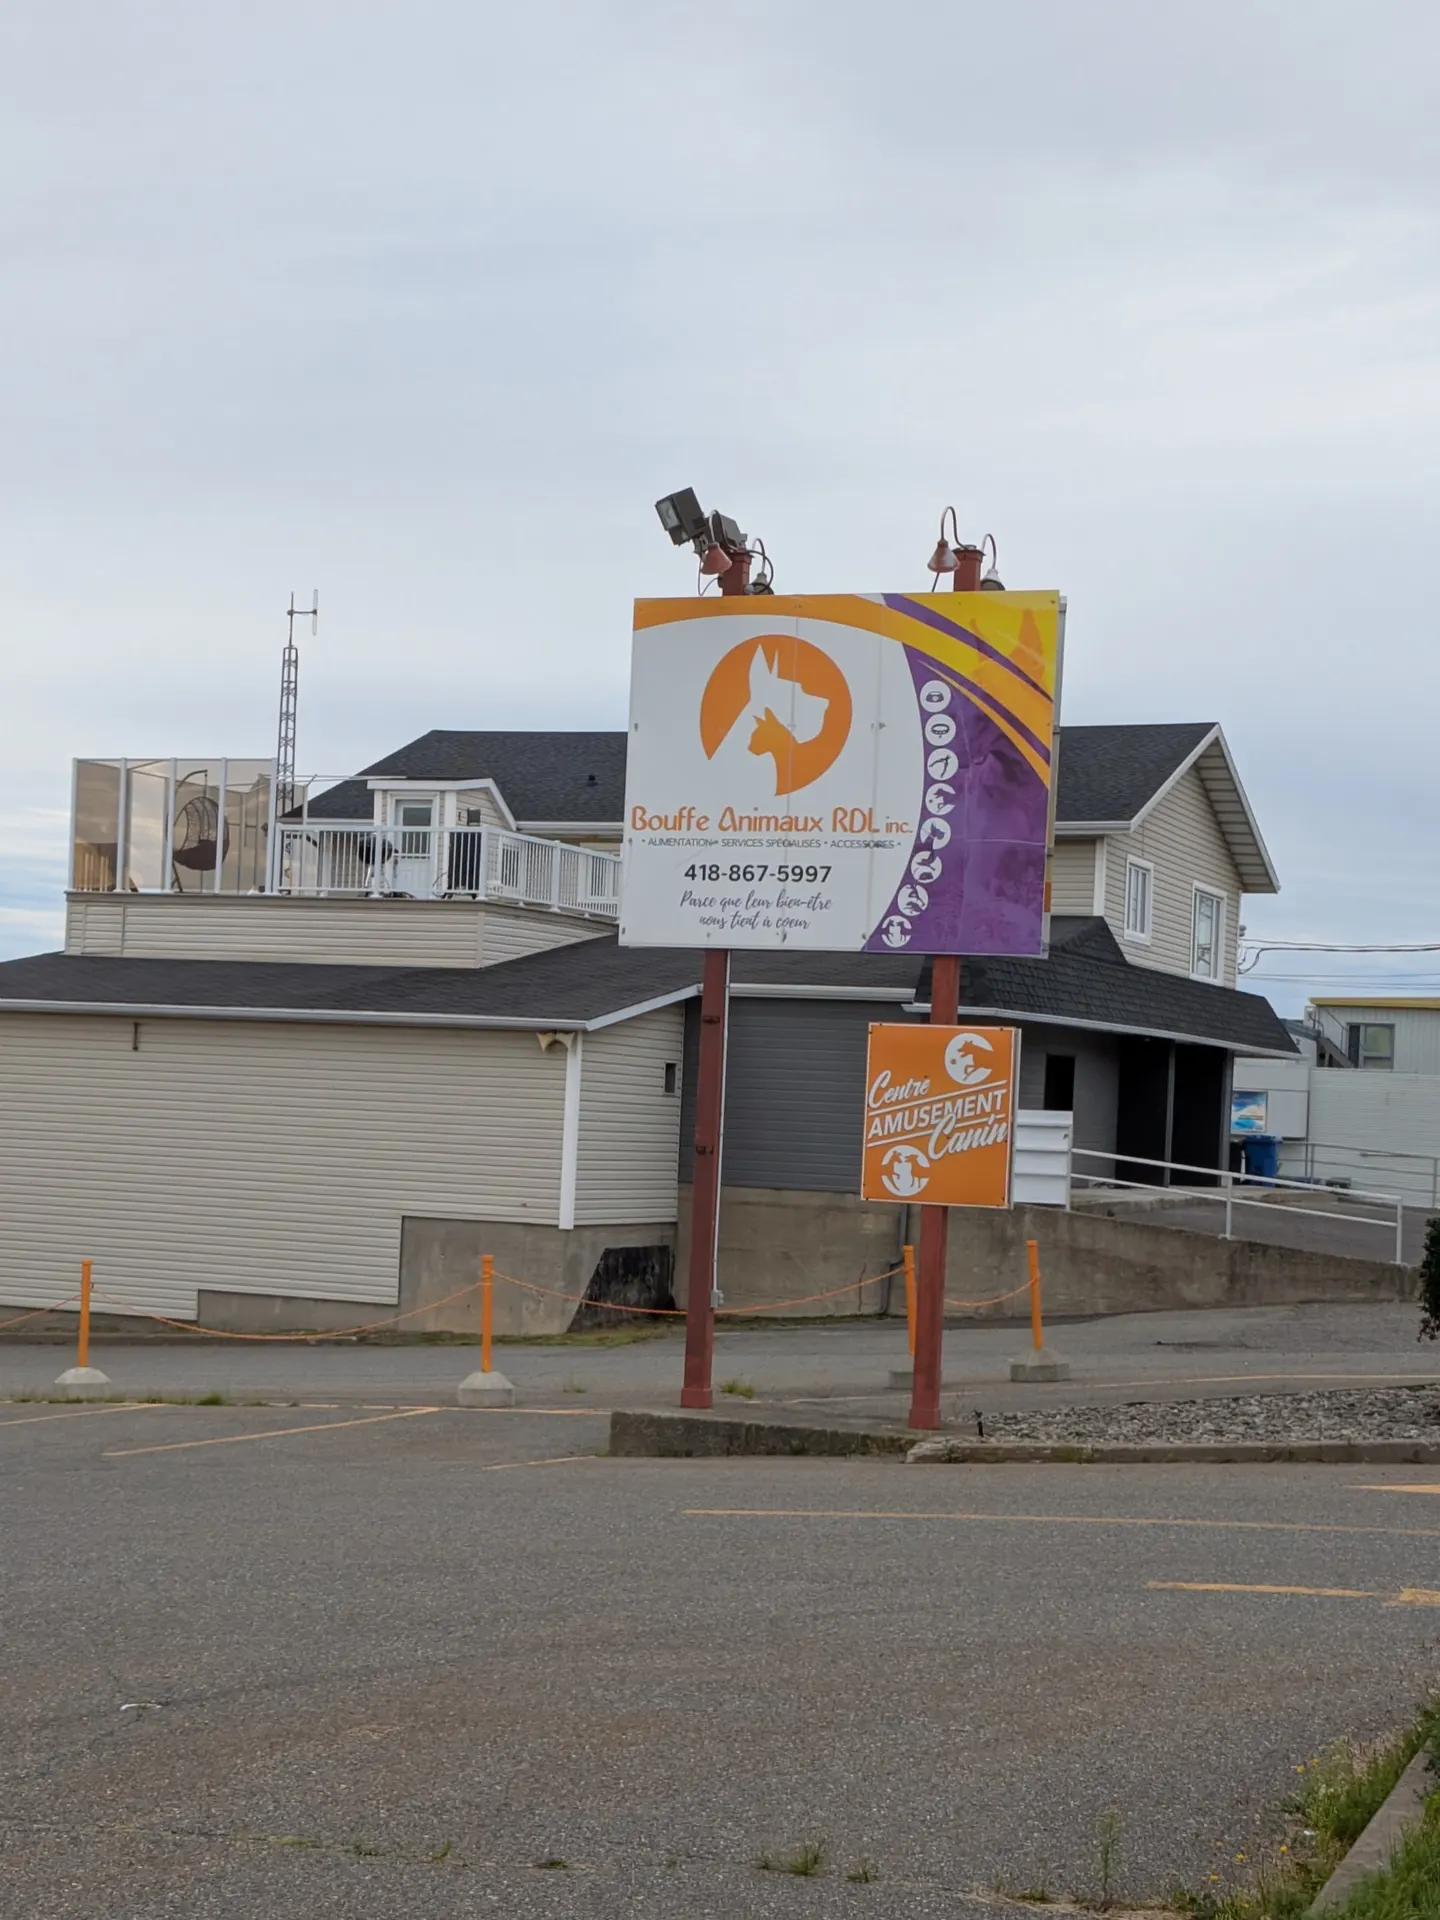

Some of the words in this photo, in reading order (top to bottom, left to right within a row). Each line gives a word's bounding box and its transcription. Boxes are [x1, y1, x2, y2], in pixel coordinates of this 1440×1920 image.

[631, 805, 710, 832] Bouffe
[718, 806, 823, 833] Animaux
[832, 807, 880, 834] RDL
[885, 815, 913, 834] inc.
[721, 838, 764, 848] SERVICES
[684, 864, 832, 883] 418-867-5997
[680, 890, 715, 907] Parce
[720, 898, 742, 912] que
[745, 889, 772, 910] leur
[699, 915, 727, 929] nous
[730, 910, 760, 930] tient
[776, 916, 811, 929] coeur
[868, 1069, 931, 1109] Centre
[867, 1089, 1008, 1139] AMUSEMENT
[928, 1112, 1008, 1160] Canin
